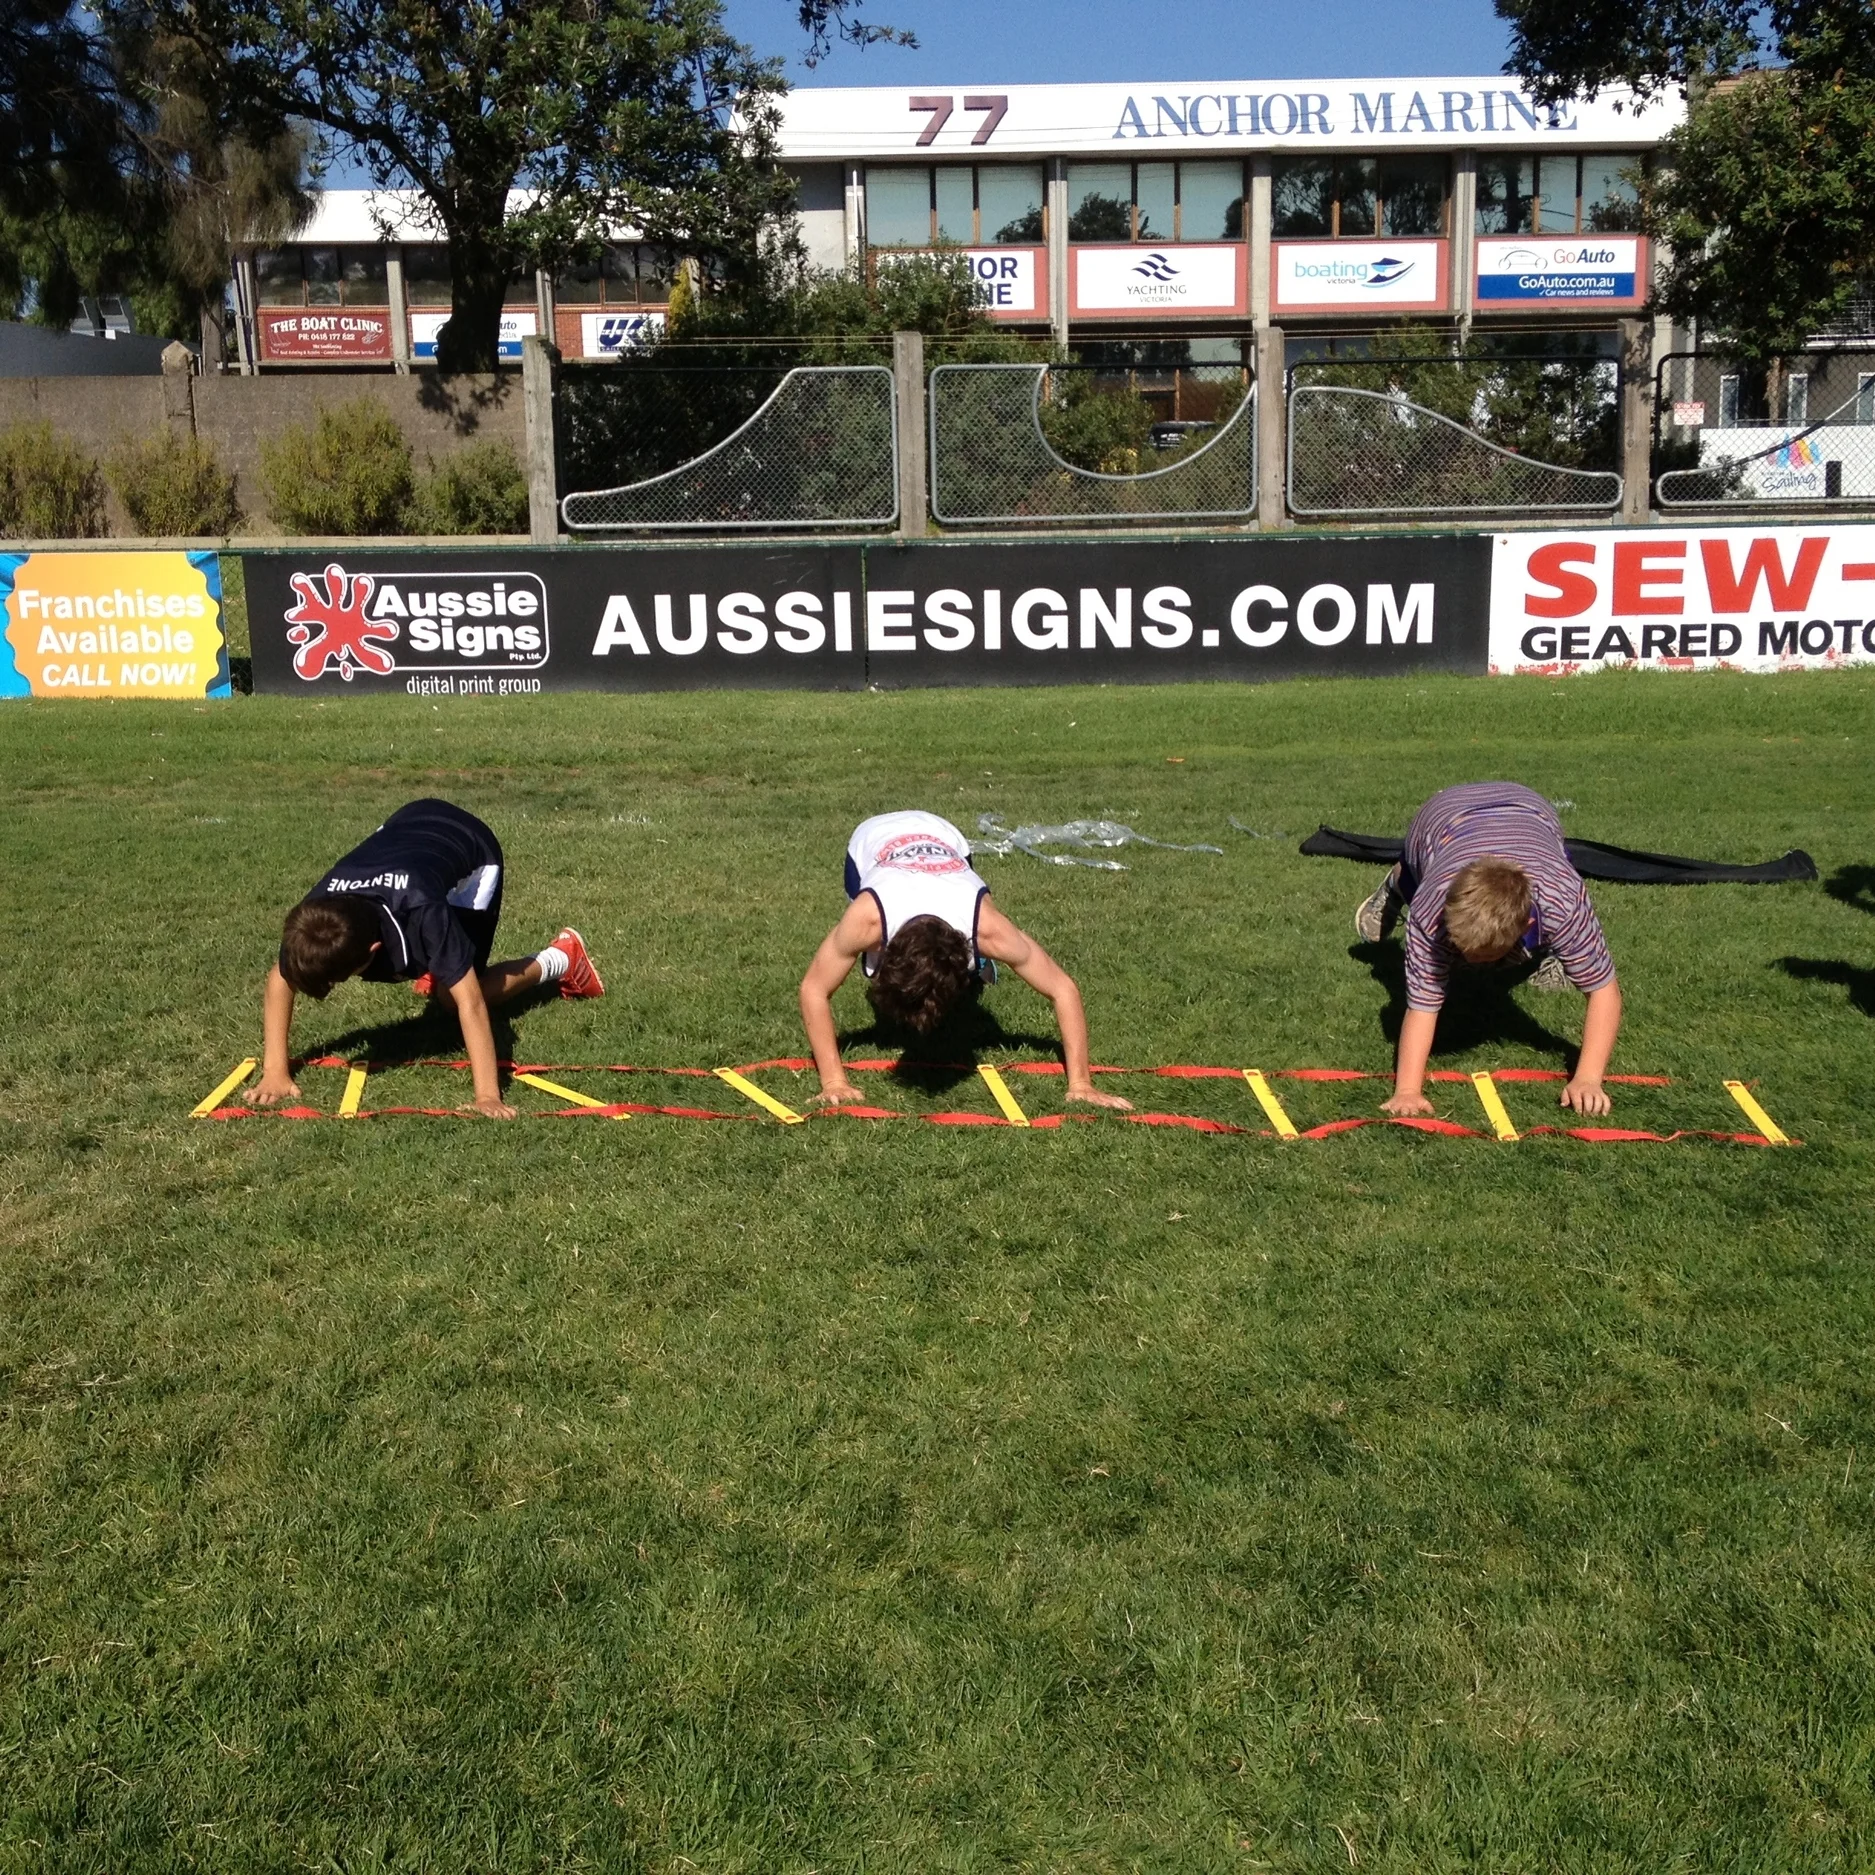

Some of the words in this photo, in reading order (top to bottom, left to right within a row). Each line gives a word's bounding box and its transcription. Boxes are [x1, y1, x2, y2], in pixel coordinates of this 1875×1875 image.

[909, 95, 1009, 146] 77
[1112, 93, 1335, 138] ANCHOR
[1349, 90, 1578, 133] MARINE
[1294, 261, 1368, 280] boating
[1327, 277, 1356, 285] victoria
[1126, 285, 1187, 295] YACHTING
[1518, 276, 1616, 289] GoAuto.com.au
[1545, 289, 1555, 297] Car
[1575, 288, 1589, 296] and
[1590, 288, 1615, 296] reviews
[270, 319, 298, 333] THE
[301, 317, 338, 331] BOAT
[340, 317, 383, 333] CLINIC
[311, 333, 328, 341] 0418
[329, 333, 341, 341] 177
[1761, 471, 1817, 493] Sailing
[18, 589, 205, 619] Franchises
[372, 583, 538, 617] Aussie
[592, 583, 1435, 655] AUSSIESIGNS.COM
[37, 624, 194, 654] Available
[408, 618, 541, 657] Signs
[1520, 623, 1742, 661] GEARED
[526, 652, 542, 660] Ltd.
[42, 664, 112, 687] CALL
[120, 663, 196, 686] NOW!
[406, 675, 454, 696] digital
[459, 675, 494, 695] print
[498, 678, 541, 696] group
[327, 873, 409, 892] MENTONE
